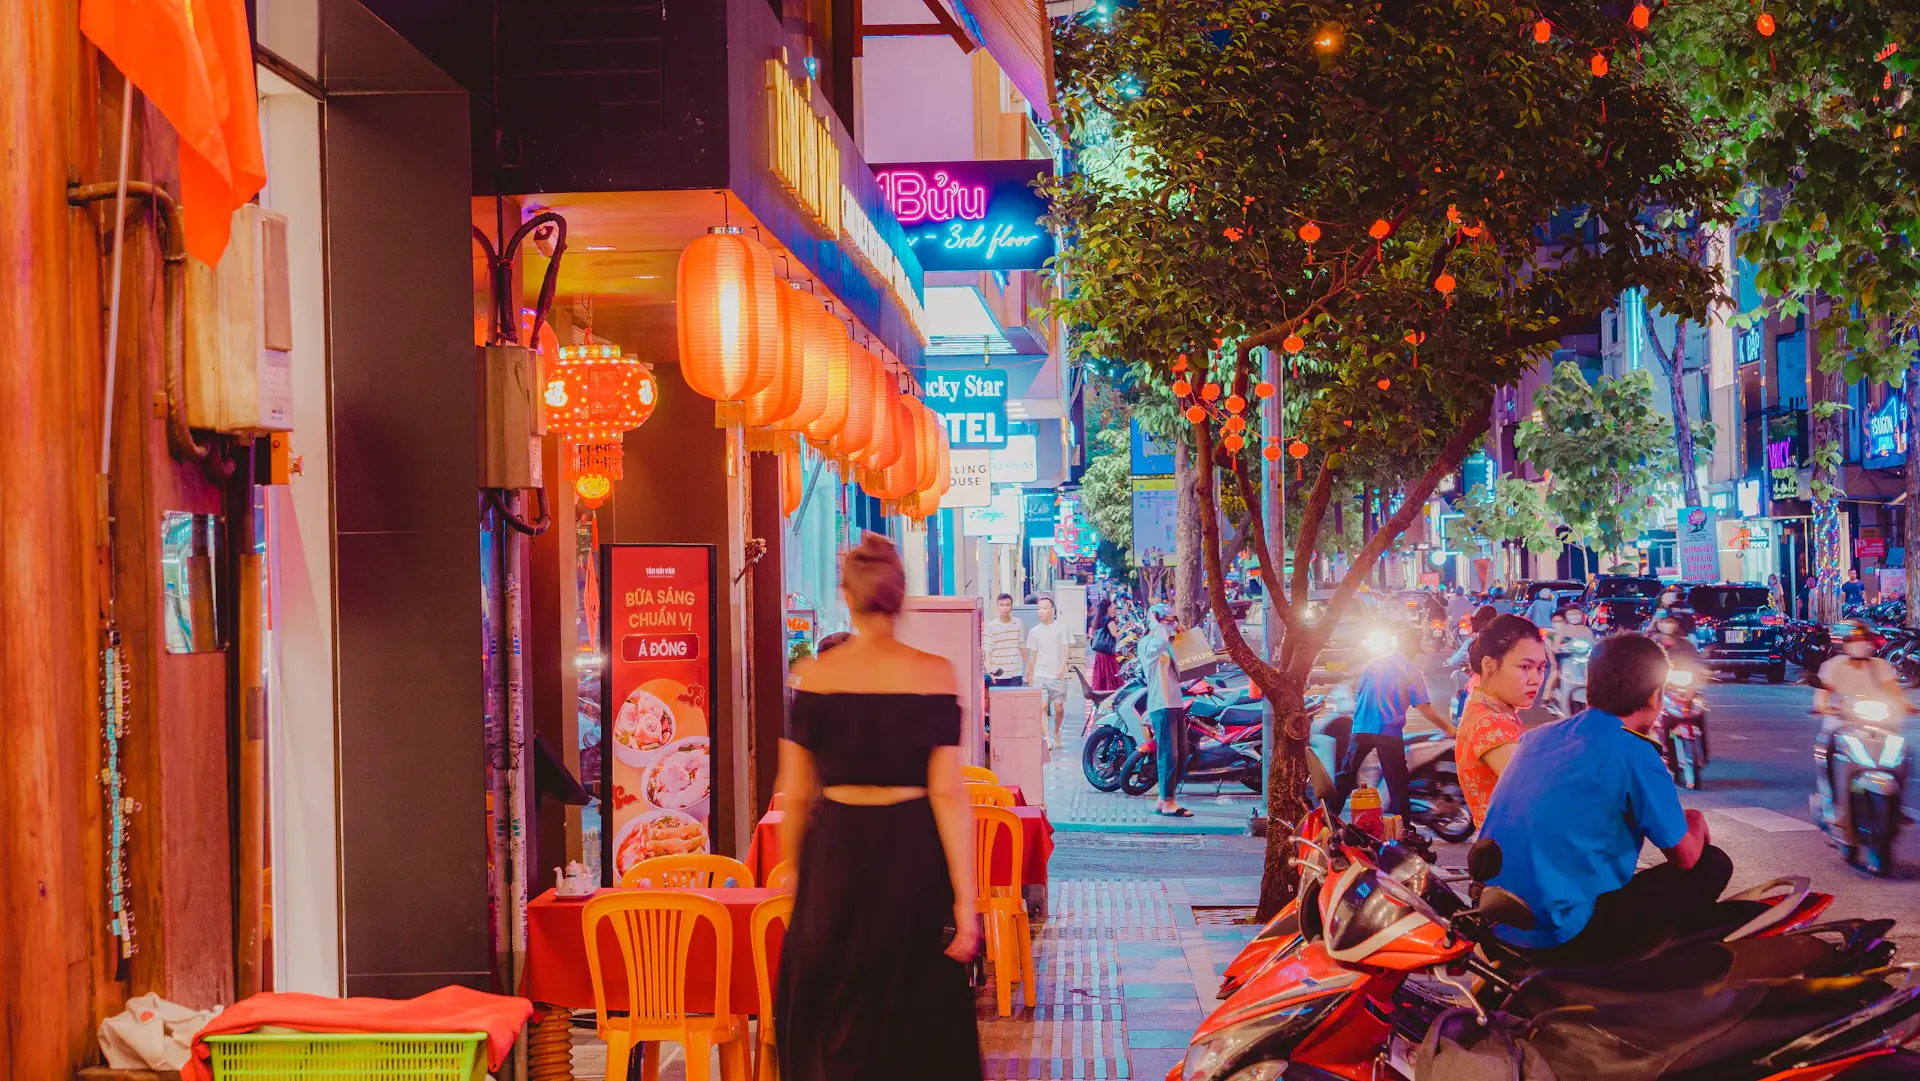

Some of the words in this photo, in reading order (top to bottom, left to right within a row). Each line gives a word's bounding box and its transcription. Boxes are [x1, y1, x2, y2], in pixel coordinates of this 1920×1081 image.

[964, 374, 1004, 397] Star
[950, 465, 987, 475] LING
[625, 587, 655, 608] BỮA
[657, 586, 696, 606] SÁNG
[628, 605, 677, 629] CHUẨN
[679, 612, 692, 632] VỊ
[638, 638, 648, 657] Á
[649, 638, 688, 657] ĐÔNG
